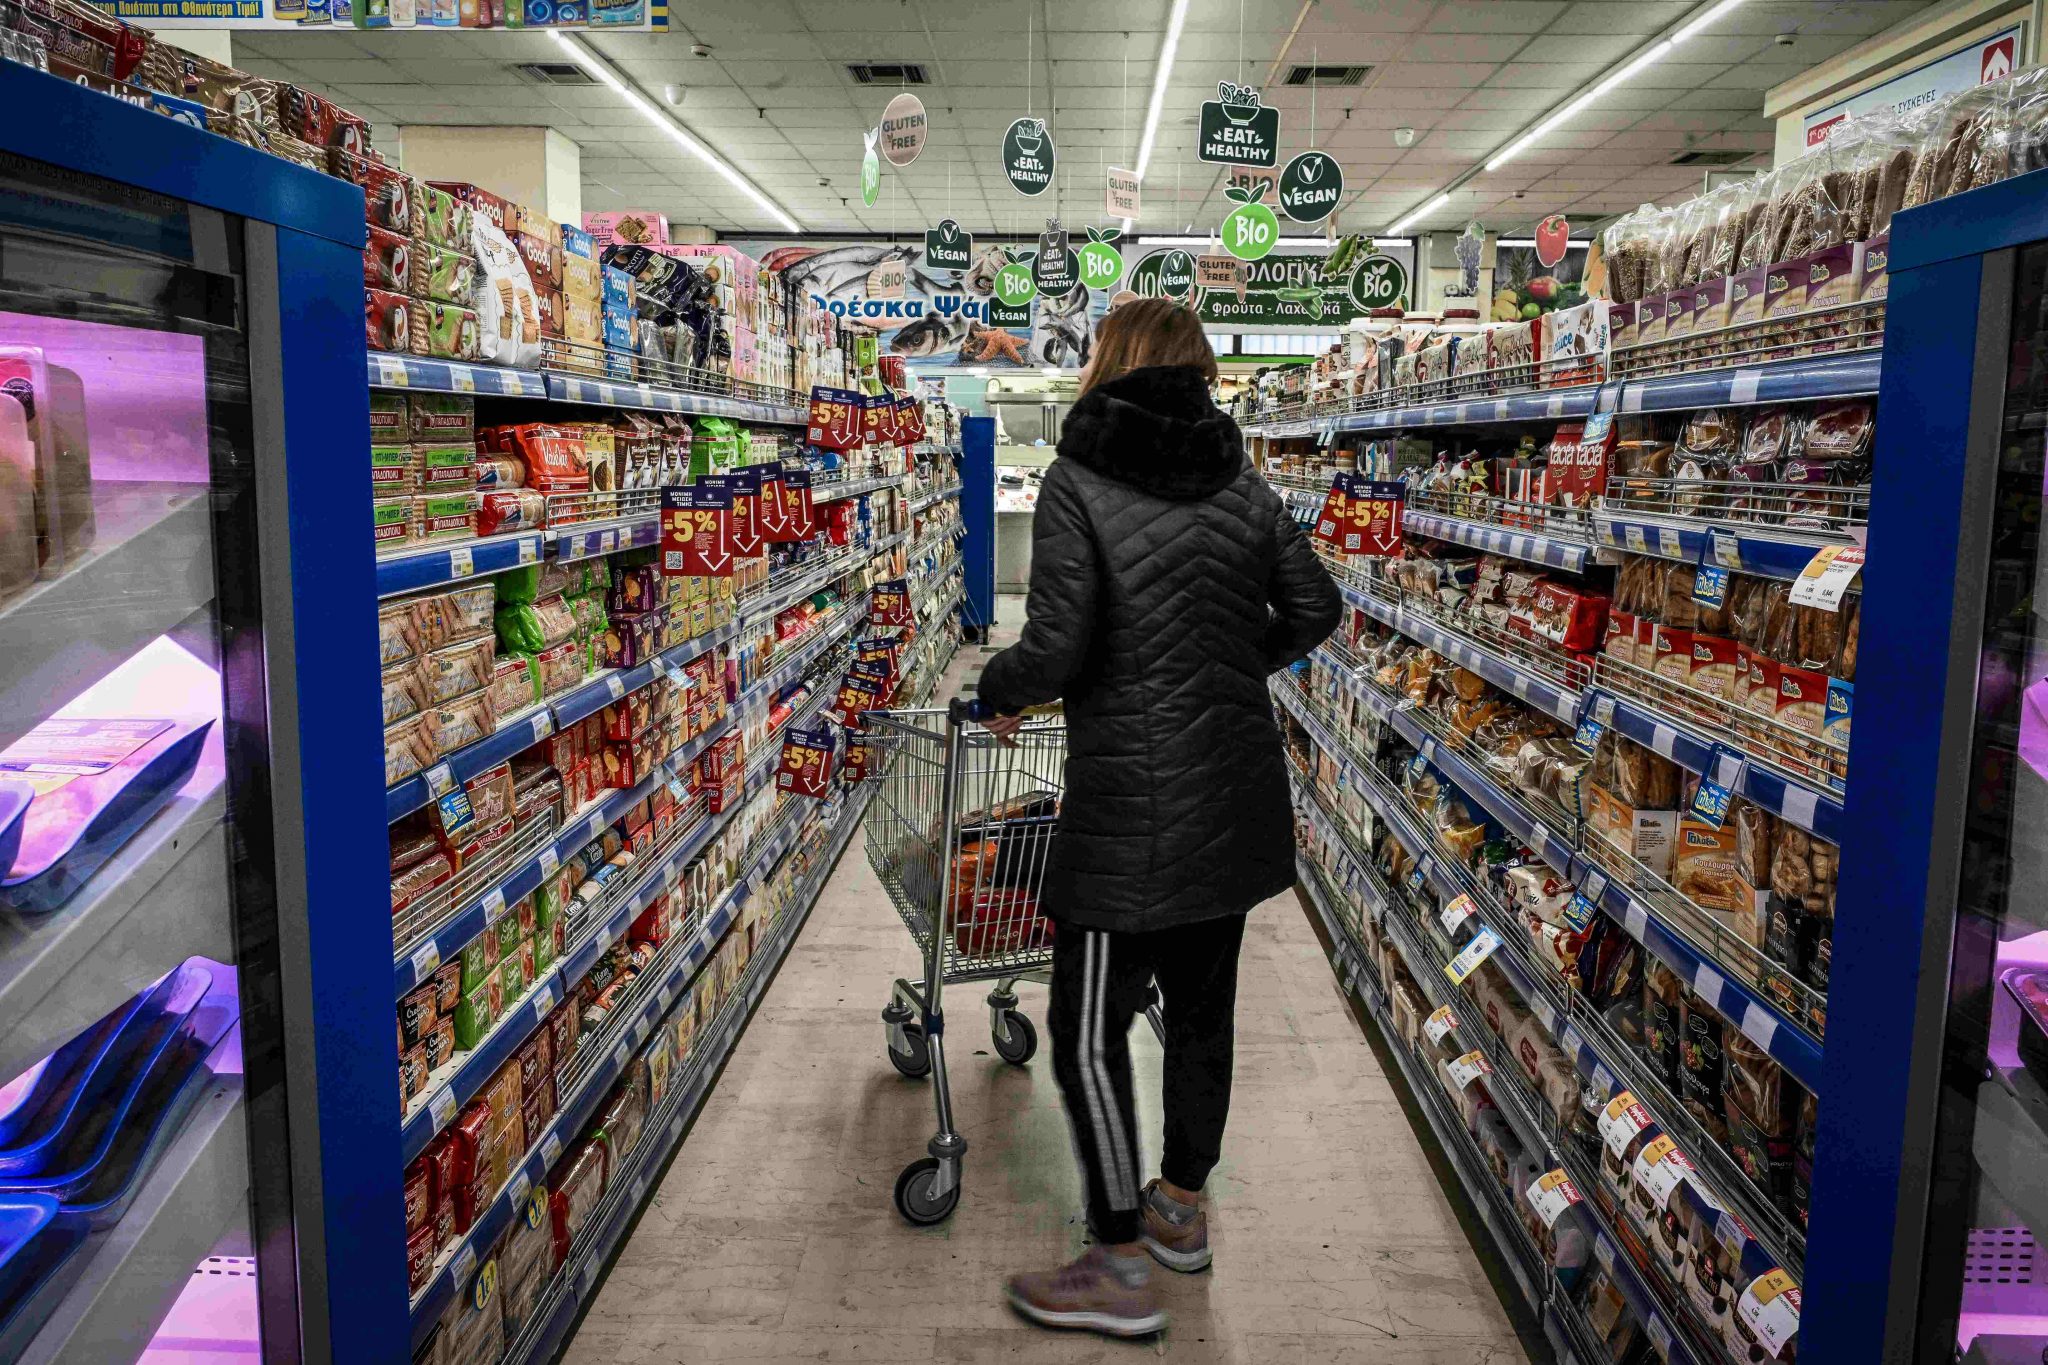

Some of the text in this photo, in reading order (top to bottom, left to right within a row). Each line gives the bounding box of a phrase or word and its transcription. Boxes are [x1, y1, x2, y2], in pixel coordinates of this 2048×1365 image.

[119, 1, 159, 15] Ποιότητα
[163, 4, 178, 15] στη
[181, 2, 232, 17] Φθηνότερη
[236, 1, 259, 17] Τιμή!
[1897, 89, 1936, 114] ΣΥΣΚΕΥΕΣ
[882, 114, 925, 132] GLUTEN
[891, 135, 916, 150] FREE
[1223, 127, 1256, 144] EAT
[1205, 143, 1270, 160] HEALTHY
[1019, 157, 1039, 169] EAT
[1010, 170, 1049, 183] HEALTHY
[1109, 177, 1138, 193] GLUTEN
[1115, 197, 1133, 209] FREE
[1283, 188, 1336, 206] VEGAN
[476, 194, 503, 228] Goody
[1235, 215, 1269, 247] BIO
[526, 241, 551, 272] Goody
[930, 246, 968, 262] VEGAN
[1046, 250, 1059, 260] EAT
[1041, 260, 1065, 271] HEALTHY
[1085, 252, 1114, 279] BIO
[1200, 261, 1236, 270] GLUTEN
[885, 277, 901, 288] BIO
[1004, 272, 1030, 297] BIO
[1038, 279, 1074, 288] HEALTHY
[1162, 273, 1190, 286] VEGAN
[1207, 273, 1230, 281] FREE
[1364, 272, 1392, 298] BIO
[992, 310, 1027, 321] VEGAN
[1212, 300, 1263, 317] Φρούτα
[612, 312, 631, 336] Goody
[811, 402, 846, 424] -5%
[1328, 492, 1346, 518] -5
[1346, 500, 1390, 527] -5%
[664, 510, 717, 543] -5%
[874, 594, 899, 611] -5%
[840, 689, 870, 708] -5%
[783, 746, 820, 769] -5%
